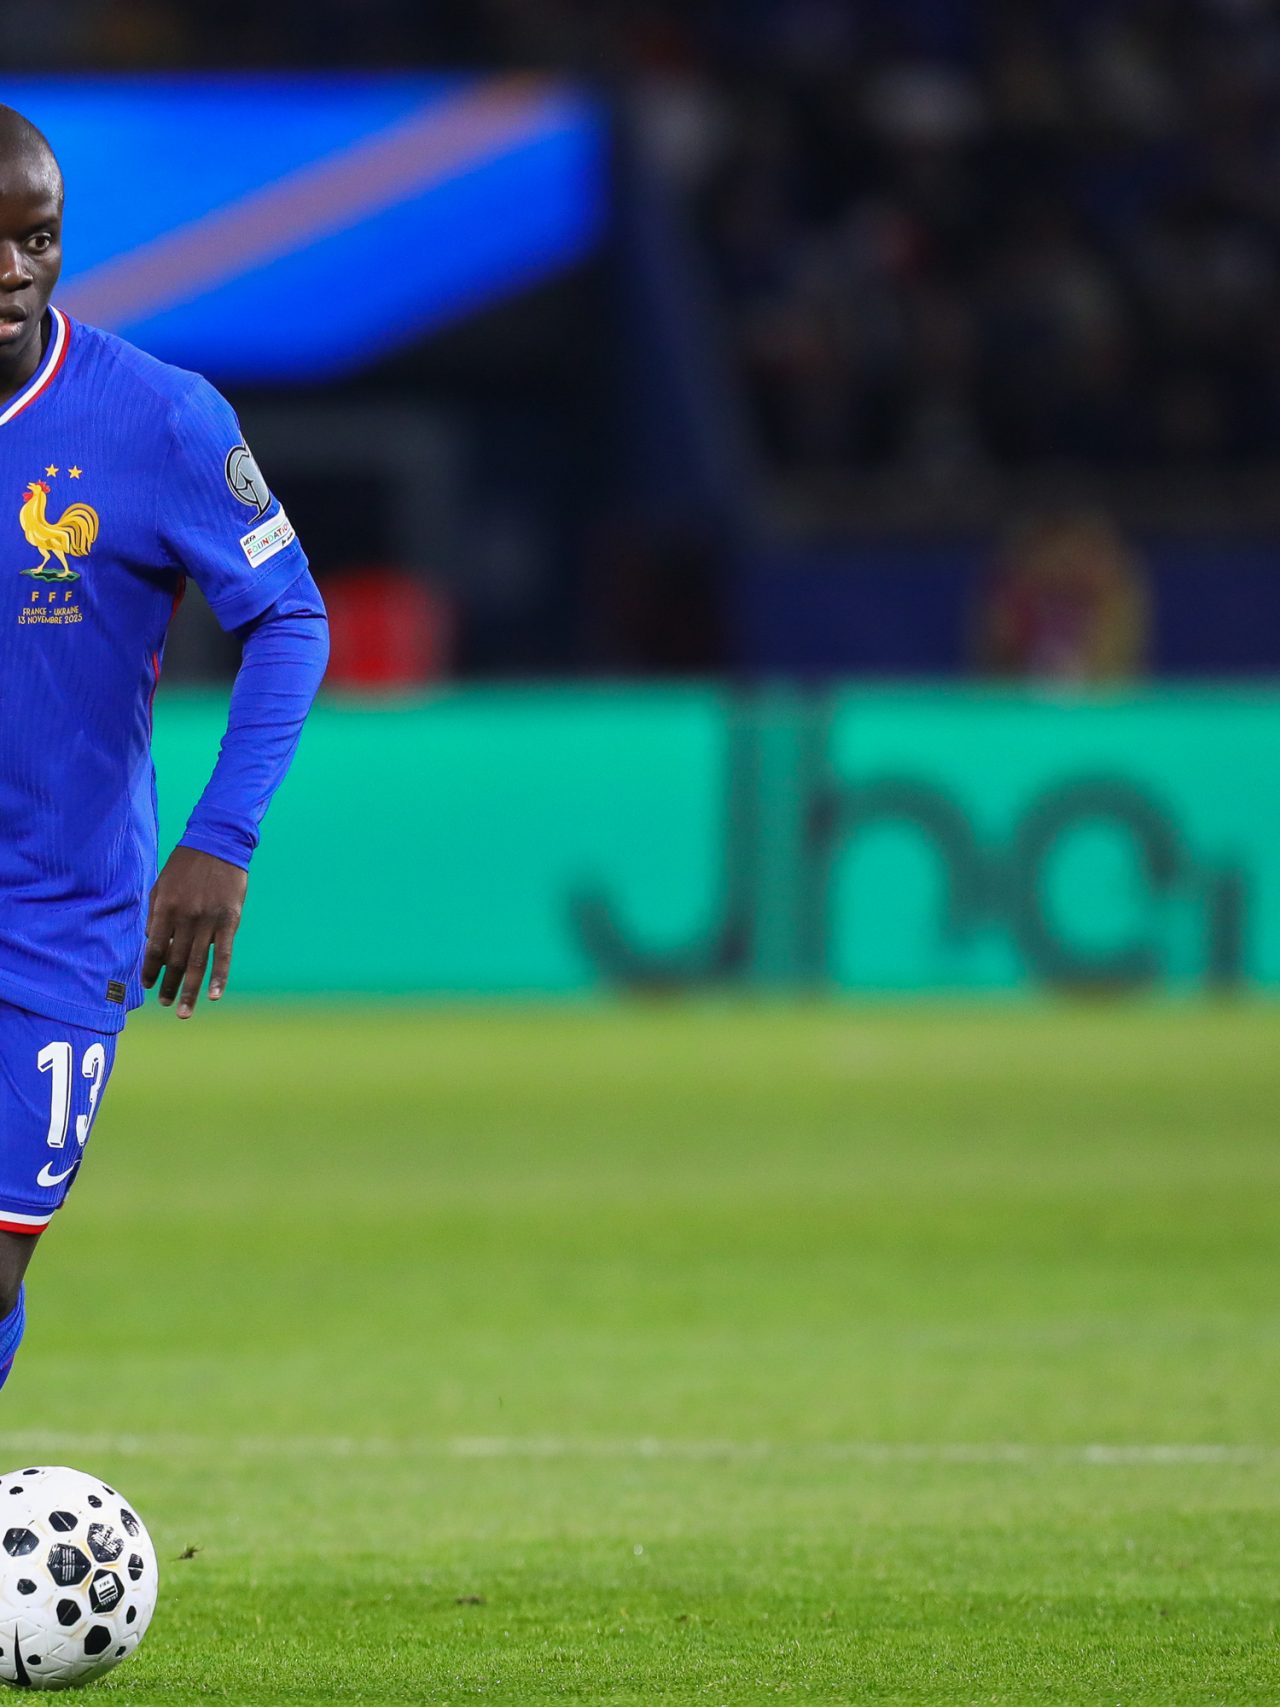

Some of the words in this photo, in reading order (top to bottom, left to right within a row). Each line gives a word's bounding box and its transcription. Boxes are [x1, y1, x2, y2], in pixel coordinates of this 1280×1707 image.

[22, 607, 47, 616] FRANCE
[53, 605, 79, 616] UKRAINE
[18, 615, 26, 624] 13
[27, 615, 62, 624] NOVEMBRE
[64, 613, 83, 624] 2025
[37, 1041, 105, 1148] 13
